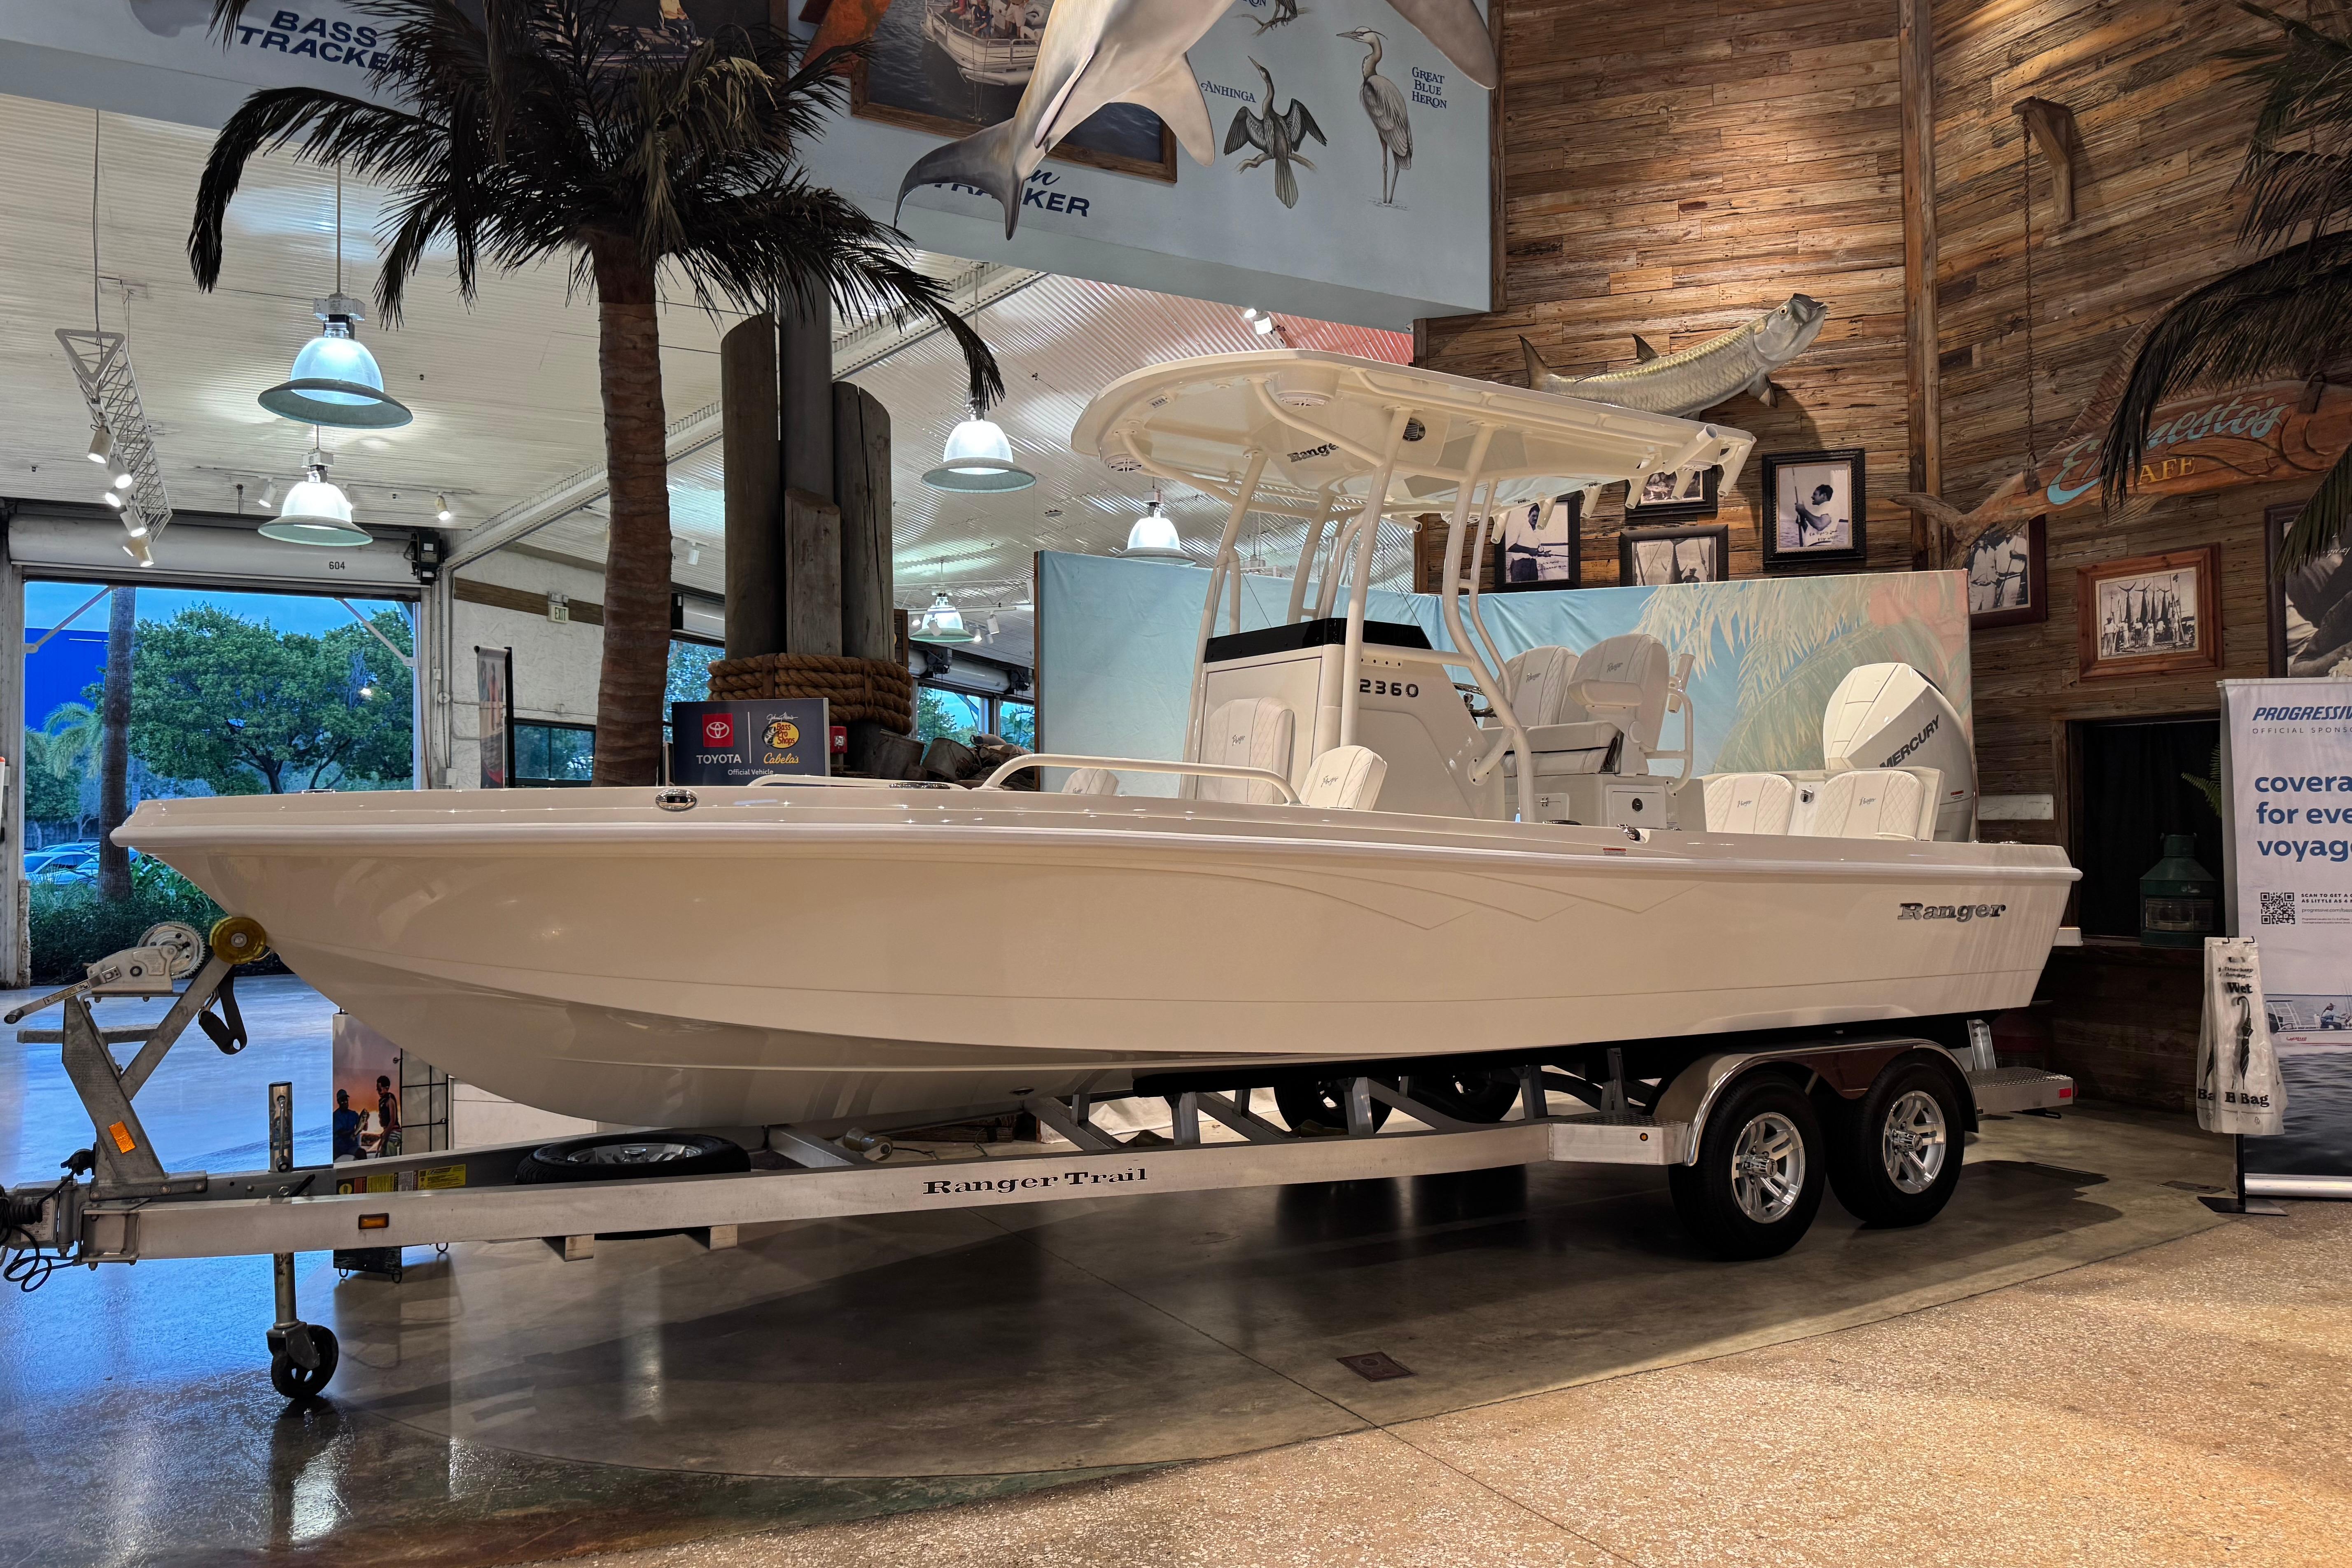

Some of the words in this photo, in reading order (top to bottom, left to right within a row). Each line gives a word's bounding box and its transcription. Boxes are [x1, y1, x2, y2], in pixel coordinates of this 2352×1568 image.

[270, 10, 378, 48] BASS
[1412, 67, 1444, 84] GREAT
[1201, 81, 1256, 103] ANHINGA
[1414, 79, 1441, 96] BLUE
[1412, 91, 1447, 109] HERON
[1287, 443, 1339, 462] Range
[2047, 396, 2290, 505] Enesto's
[2126, 457, 2196, 488] AFE
[329, 561, 345, 570] 604
[1359, 679, 1419, 698] 2360
[777, 737, 795, 745] Shops
[1879, 714, 1939, 768] MERCURY
[696, 754, 742, 764] TOYOTA
[763, 752, 799, 764] Cabela's
[2256, 801, 2298, 824] for
[2257, 840, 2352, 862] voyag
[1897, 902, 2006, 922] Ranger
[2226, 982, 2253, 994] Wet
[2240, 1093, 2270, 1108] Bag
[922, 1175, 1058, 1195] Ranger
[1064, 1167, 1148, 1186] Trail
